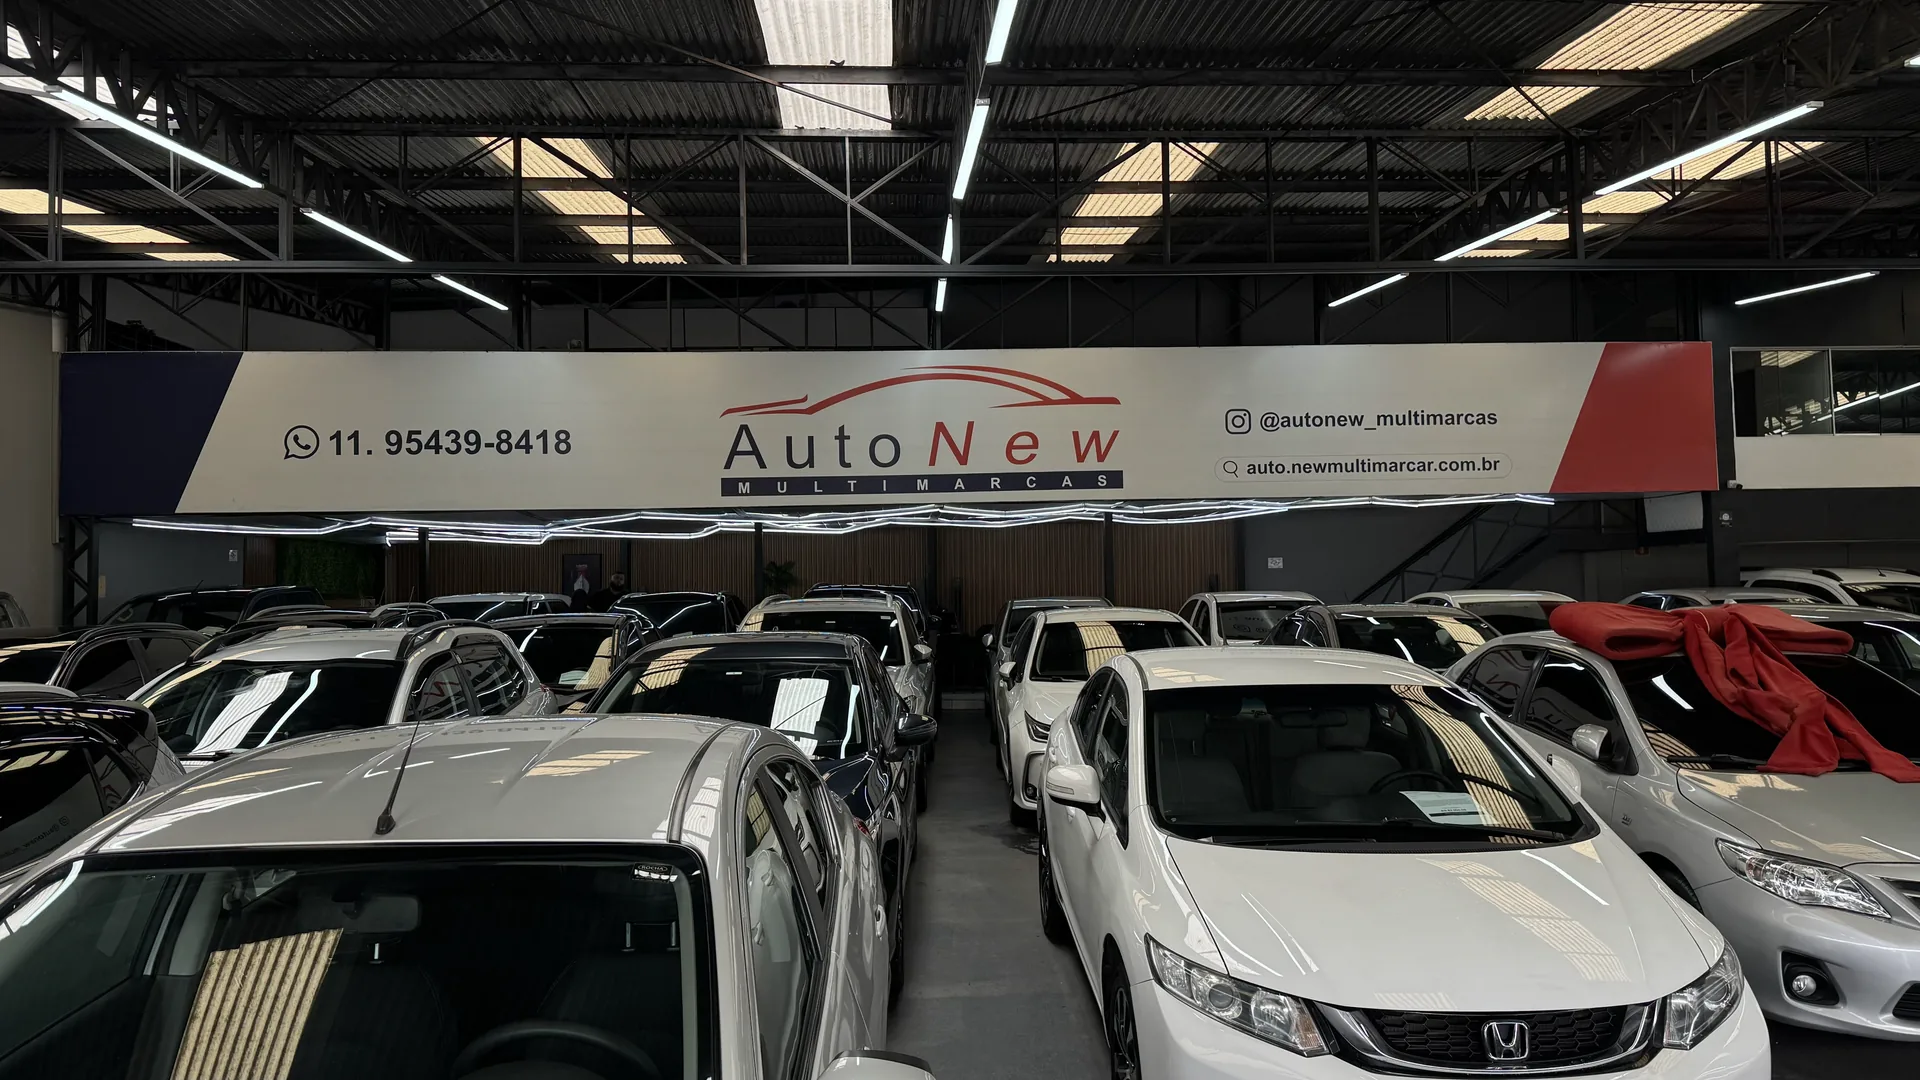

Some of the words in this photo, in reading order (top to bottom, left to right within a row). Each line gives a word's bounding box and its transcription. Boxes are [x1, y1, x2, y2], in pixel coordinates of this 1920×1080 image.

[1259, 409, 1499, 432] @autonew_multimarcas
[329, 429, 373, 456] 11.
[385, 429, 572, 456] 95439-8418
[723, 424, 901, 470] Auto
[928, 420, 1120, 467] New
[1246, 457, 1501, 475] auto.newmultimarcar.com.br
[738, 474, 1108, 494] MULTIMARCAS
